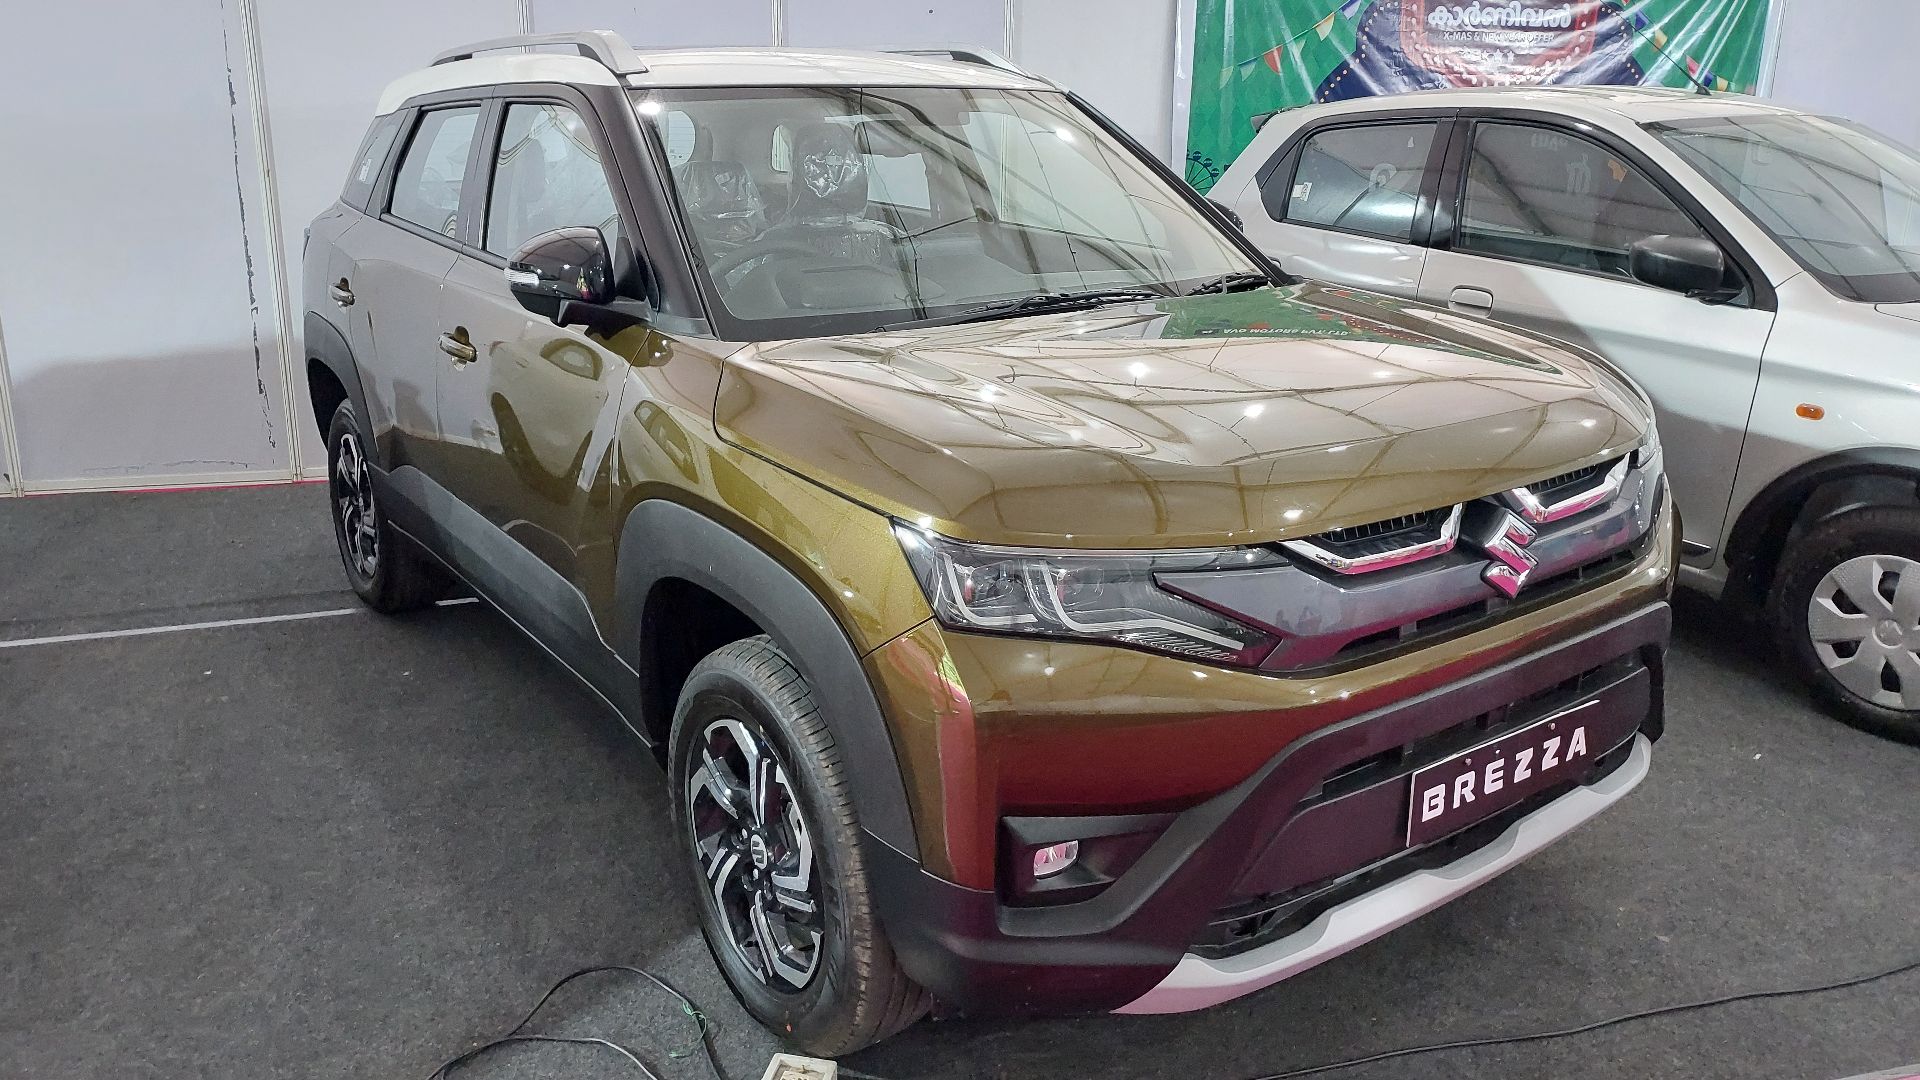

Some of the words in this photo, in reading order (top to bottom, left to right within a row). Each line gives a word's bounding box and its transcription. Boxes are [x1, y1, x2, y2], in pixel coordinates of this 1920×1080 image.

[1443, 31, 1472, 41] X-MAS
[1473, 32, 1480, 41] &
[1481, 32, 1502, 42] NEW
[1421, 726, 1587, 822] BREZZA
